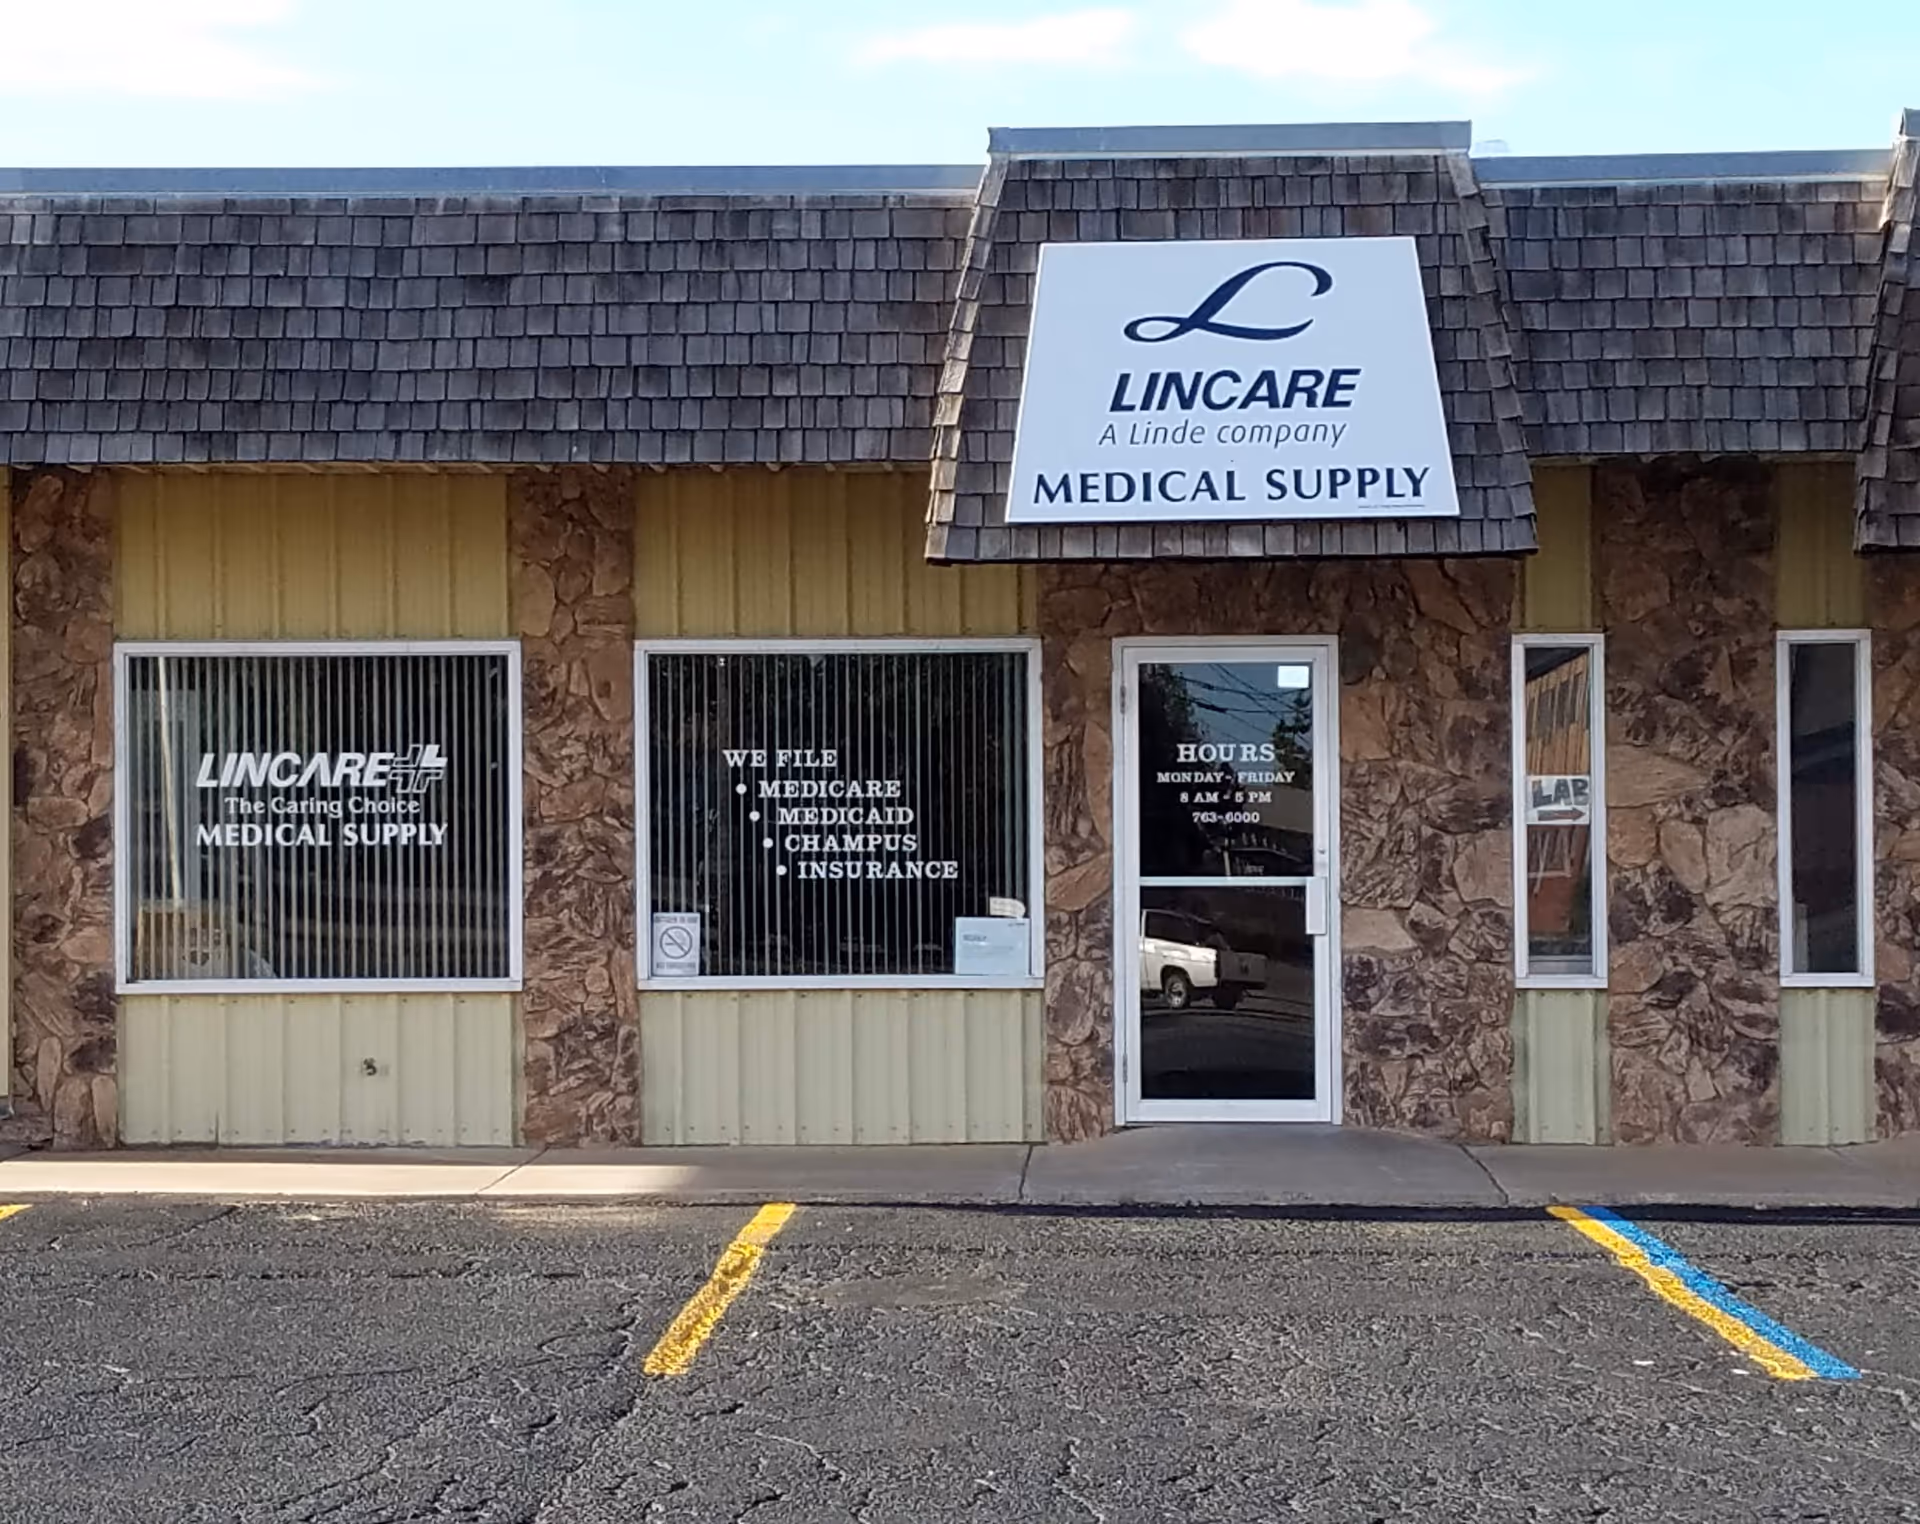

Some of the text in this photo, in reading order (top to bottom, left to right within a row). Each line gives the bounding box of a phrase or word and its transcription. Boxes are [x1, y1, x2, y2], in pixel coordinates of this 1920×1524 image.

[1109, 368, 1362, 413] LINCARE
[1098, 419, 1347, 449] A Linde company
[1033, 467, 1430, 505] MEDICAL SUPPLY
[723, 749, 838, 767] WE FILE
[1176, 743, 1275, 763] HOURS
[195, 752, 395, 788] LINCARE
[1238, 771, 1296, 784] FRIDAY
[758, 780, 901, 798] MEDICARE
[1193, 792, 1220, 803] AM
[1235, 792, 1244, 803] 5
[1248, 792, 1272, 803] PM
[1532, 778, 1588, 808] LAB
[223, 796, 421, 819] The Caring Choice
[779, 807, 914, 825] MEDICAID
[196, 823, 448, 847] MEDICAL SUPPLY
[785, 834, 917, 852] CHAMPUS
[798, 861, 959, 879] INSURANCE
